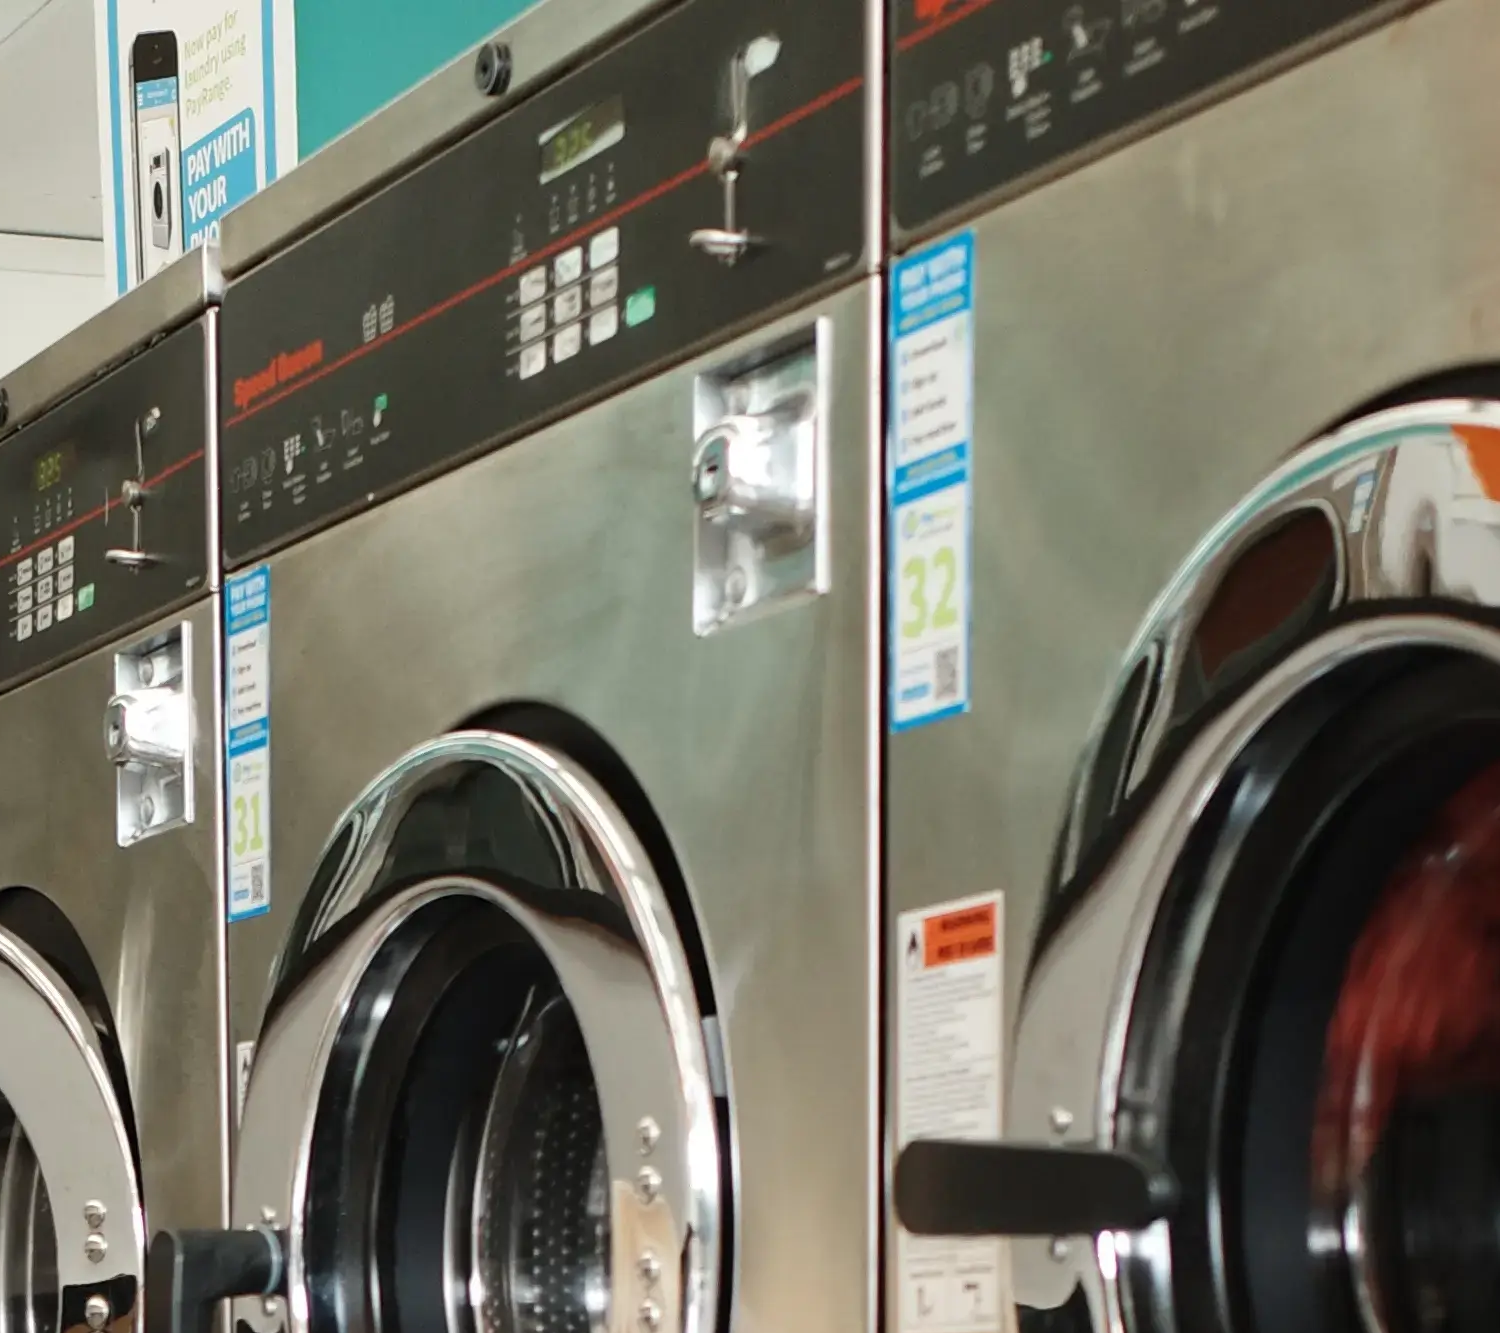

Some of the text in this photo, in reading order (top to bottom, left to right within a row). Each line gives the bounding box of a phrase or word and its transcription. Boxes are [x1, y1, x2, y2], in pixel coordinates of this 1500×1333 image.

[184, 9, 240, 60] Now pay for
[184, 34, 247, 91] laundry using
[187, 117, 251, 186] PAY WITH
[188, 175, 227, 224] YOUR
[902, 545, 958, 638] 32
[233, 791, 264, 857] 31
